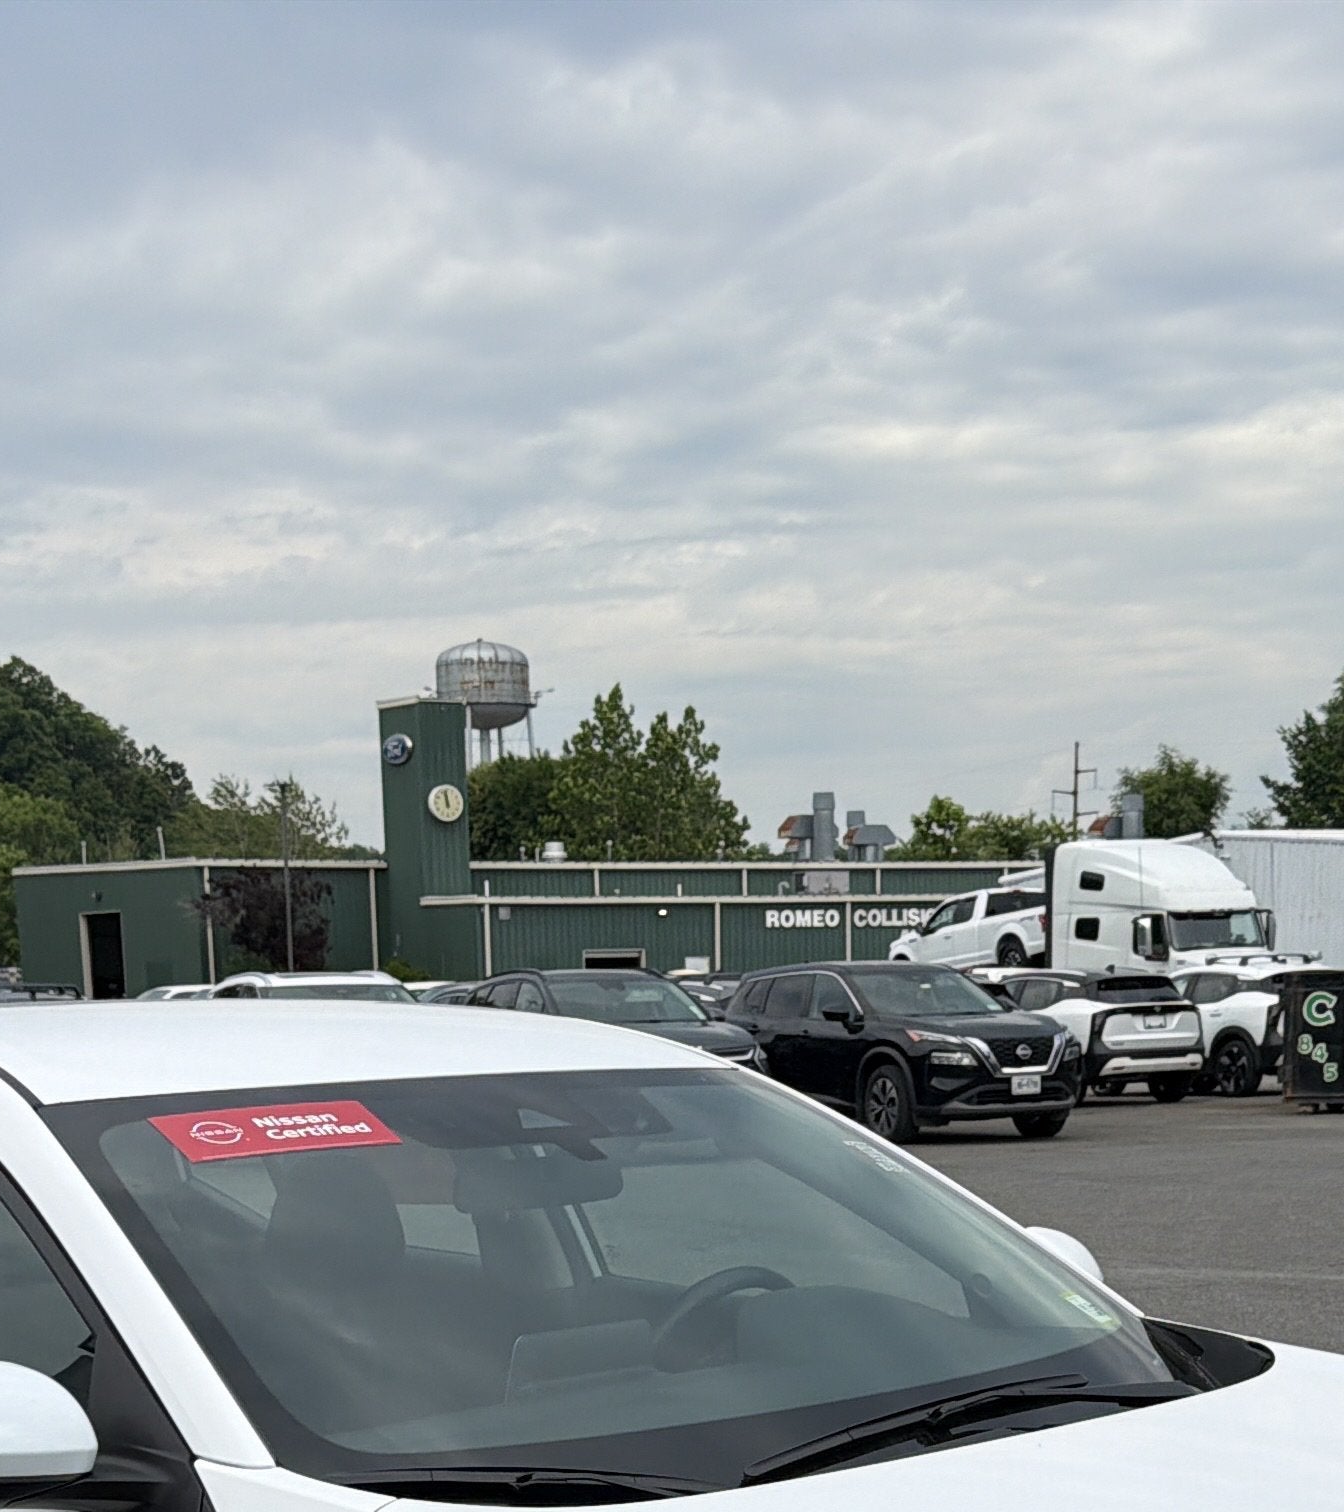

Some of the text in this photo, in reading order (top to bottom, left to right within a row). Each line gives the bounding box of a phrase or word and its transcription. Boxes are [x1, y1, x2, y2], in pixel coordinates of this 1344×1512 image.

[765, 909, 840, 928] ROMEO
[251, 1112, 338, 1128] Nissan
[265, 1122, 373, 1140] Certified
